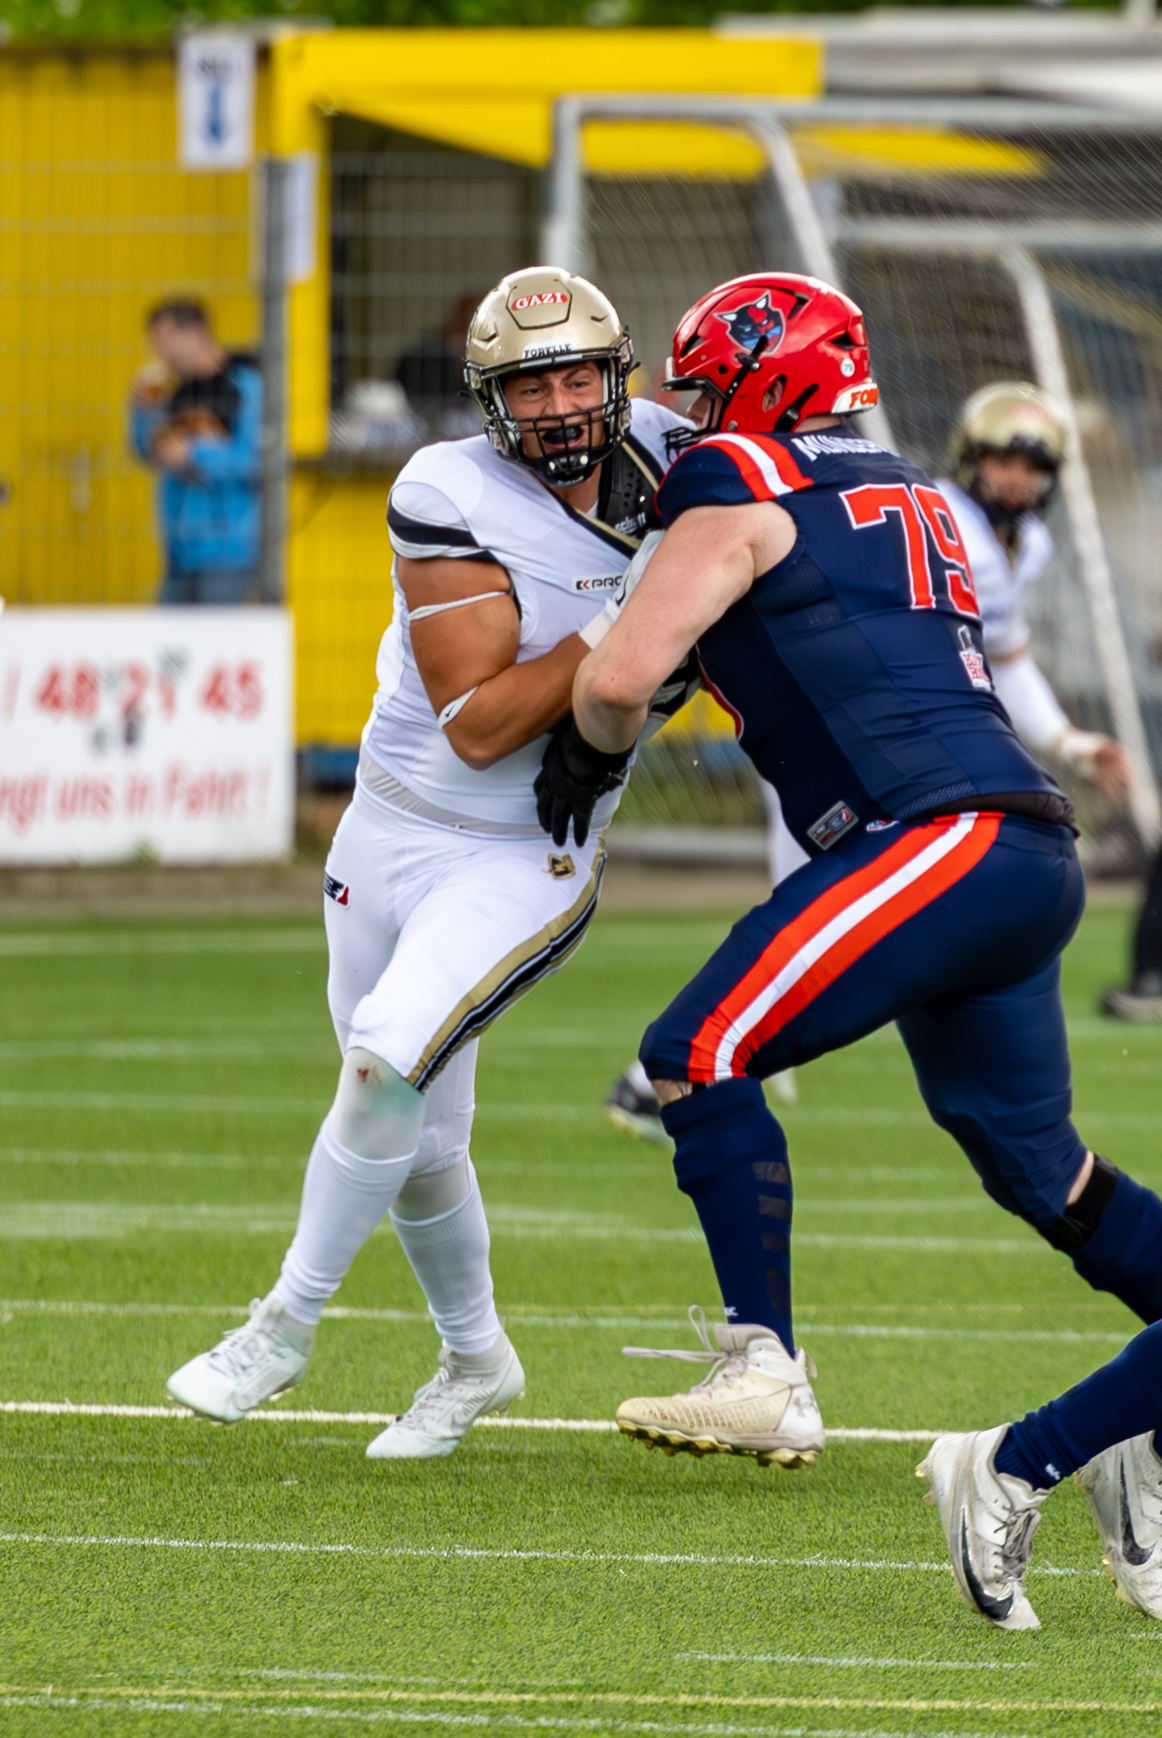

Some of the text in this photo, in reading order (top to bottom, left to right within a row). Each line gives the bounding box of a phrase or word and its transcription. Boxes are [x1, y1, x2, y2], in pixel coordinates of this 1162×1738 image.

[515, 292, 563, 310] GAZI
[839, 483, 980, 618] 79
[38, 662, 98, 720] 48
